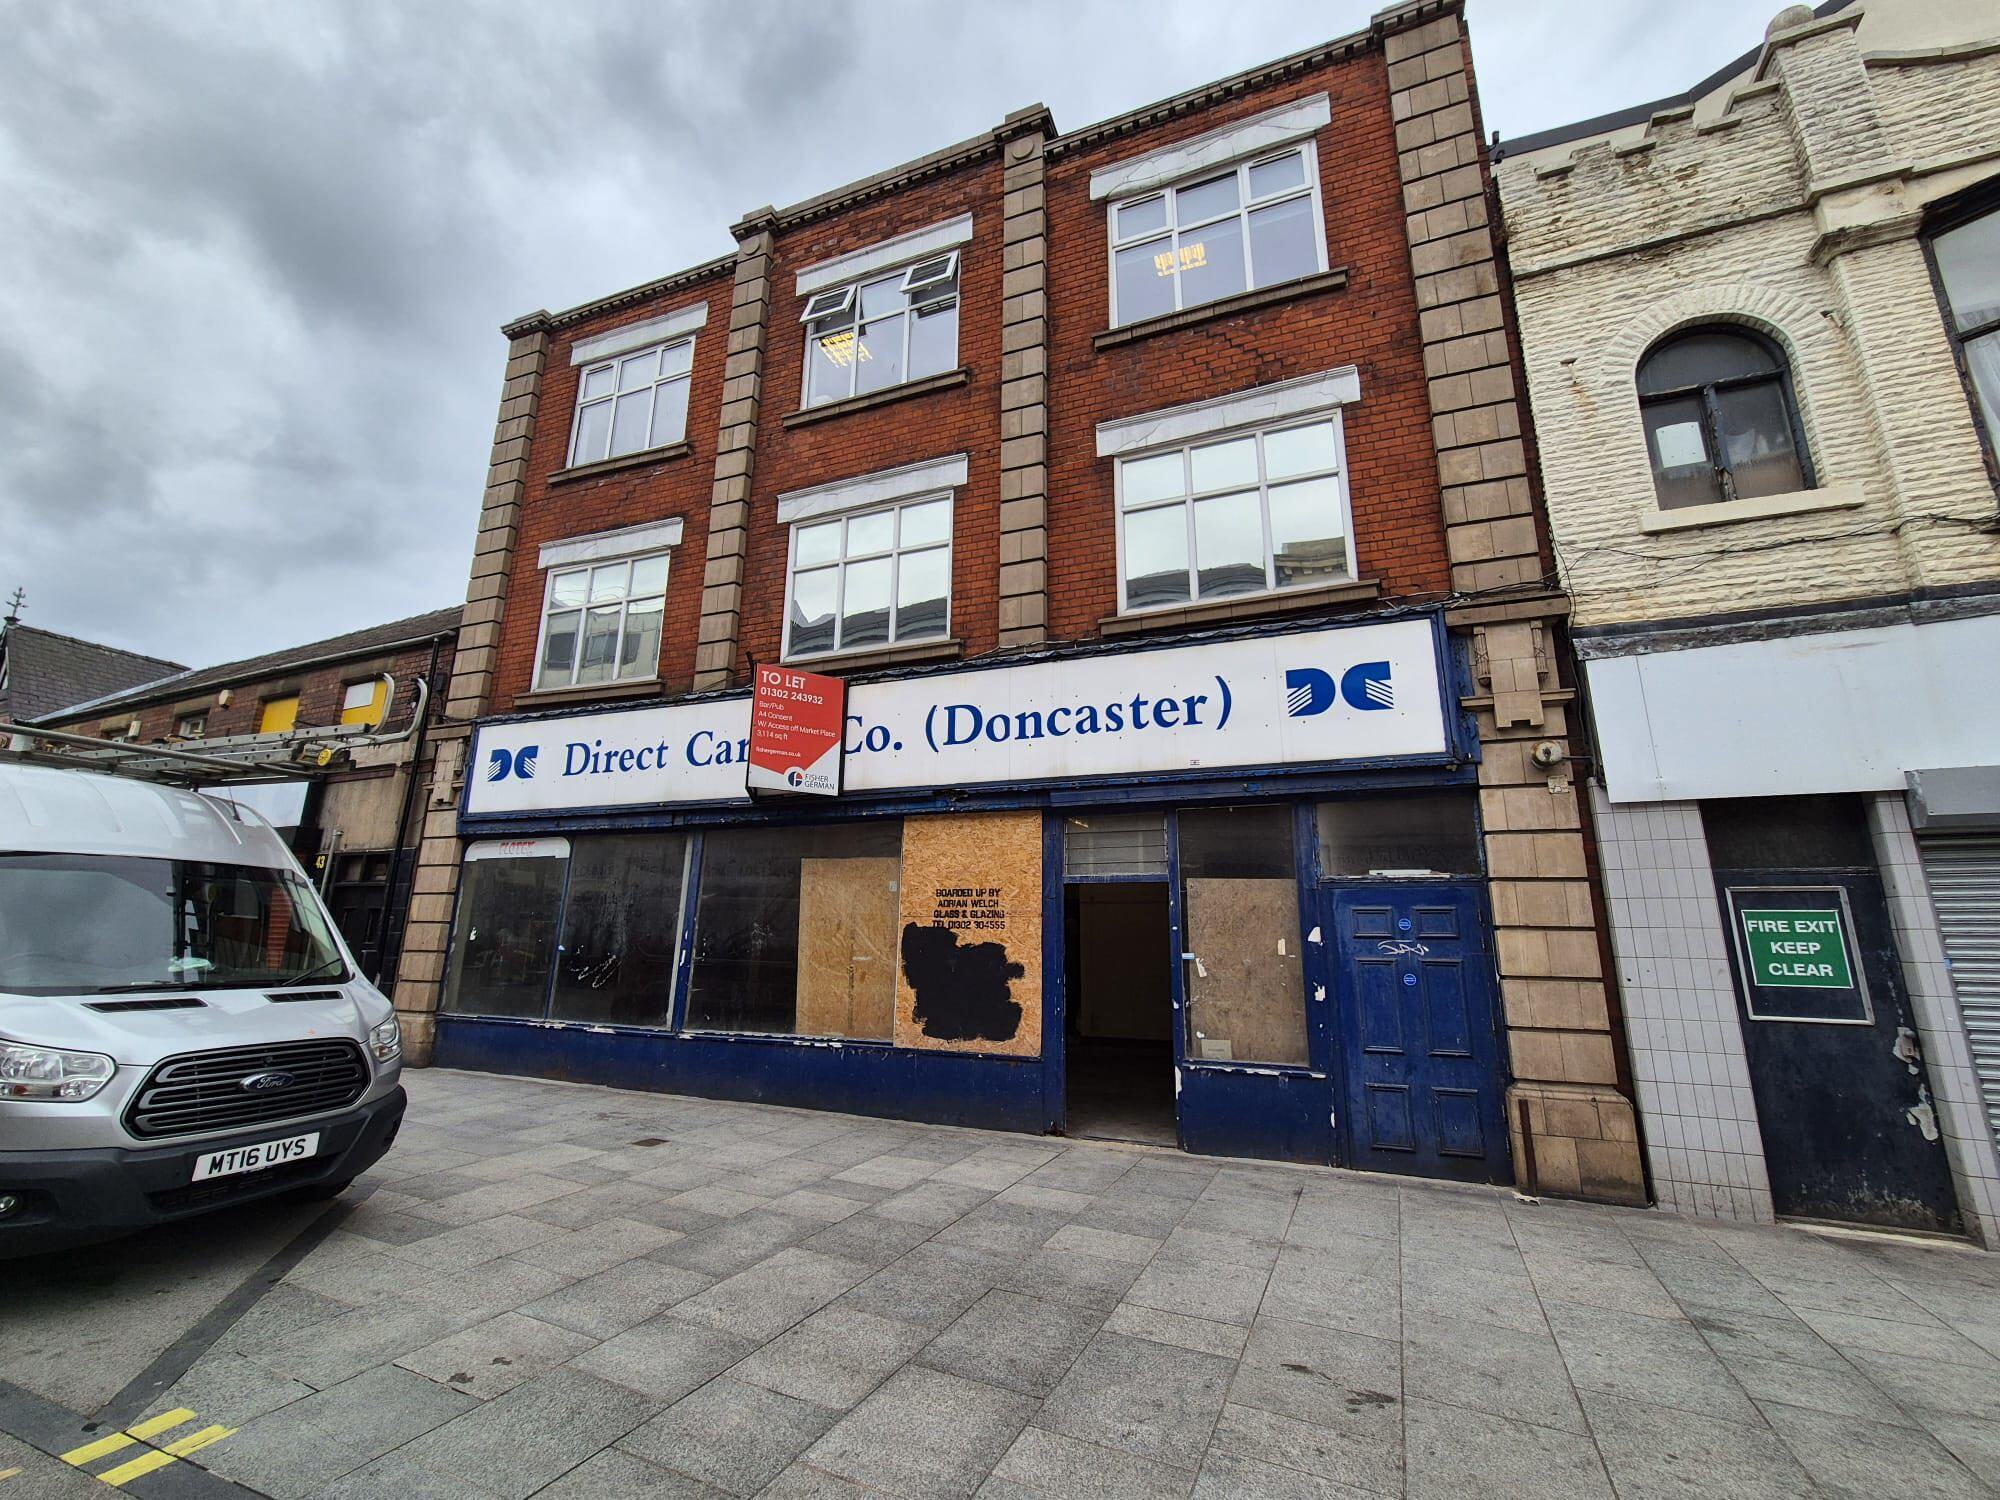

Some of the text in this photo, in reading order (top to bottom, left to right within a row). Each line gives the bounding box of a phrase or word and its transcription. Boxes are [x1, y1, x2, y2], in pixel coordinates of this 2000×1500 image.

[761, 670, 806, 690] TO LET
[760, 686, 823, 705] 01302 243932
[759, 700, 784, 711] Bar/Pub
[758, 710, 793, 722] A4 Consent
[562, 739, 669, 777] Direct
[686, 730, 750, 767] Car
[925, 675, 1232, 753] (Doncaster)
[757, 719, 767, 728] W/
[767, 721, 789, 732] Access
[799, 726, 820, 736] Market
[820, 729, 836, 738] Place
[774, 733, 783, 741] sq
[783, 732, 788, 741] ft
[756, 746, 801, 758] fishergerman.co.uk
[804, 773, 829, 783] FISHER
[804, 780, 835, 790] GERMAN
[315, 855, 326, 869] 43
[936, 888, 1001, 898] BOARDED UP BY
[937, 899, 999, 908] ADRIAN WELCH
[933, 909, 1005, 919] GLASS & GLAZING
[947, 920, 971, 930] 01302
[973, 920, 1006, 930] 304555
[1747, 920, 1836, 933] FIRE EXIT
[1770, 941, 1821, 955] KEEP
[1768, 962, 1834, 977] CLEAR
[256, 1076, 284, 1089] Ford
[208, 1138, 306, 1175] MT16 UYS
